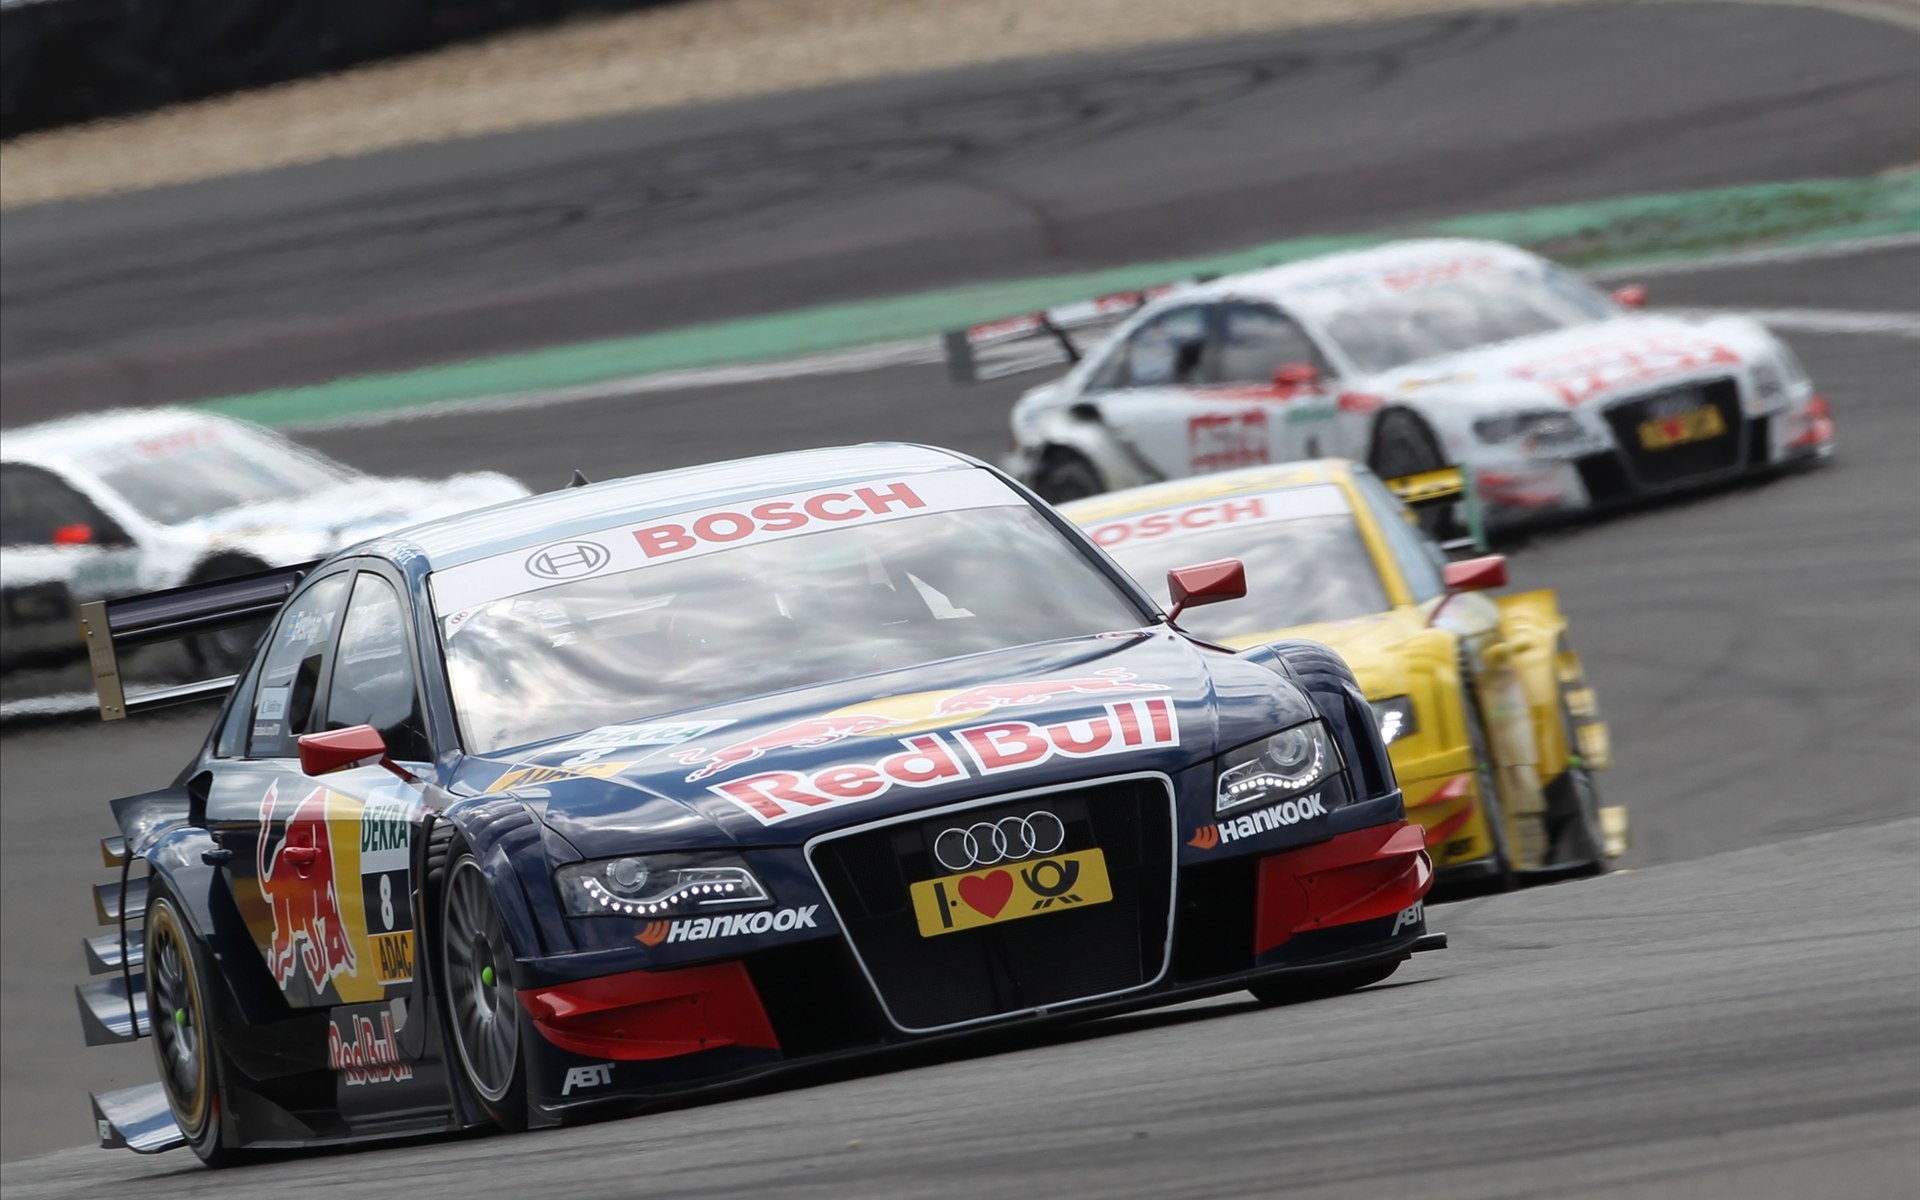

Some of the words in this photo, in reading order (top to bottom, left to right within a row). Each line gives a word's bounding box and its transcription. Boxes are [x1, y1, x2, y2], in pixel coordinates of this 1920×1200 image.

[632, 482, 926, 558] BOSCH
[1091, 498, 1266, 547] OSCH
[706, 733, 971, 826] Red
[951, 696, 1180, 776] Bull
[361, 804, 408, 853] DEKRA
[379, 873, 394, 931] 8
[1391, 900, 1423, 936] ABT
[379, 933, 412, 980] ADAC
[360, 1010, 413, 1083] Bull
[561, 1063, 616, 1096] ABT
